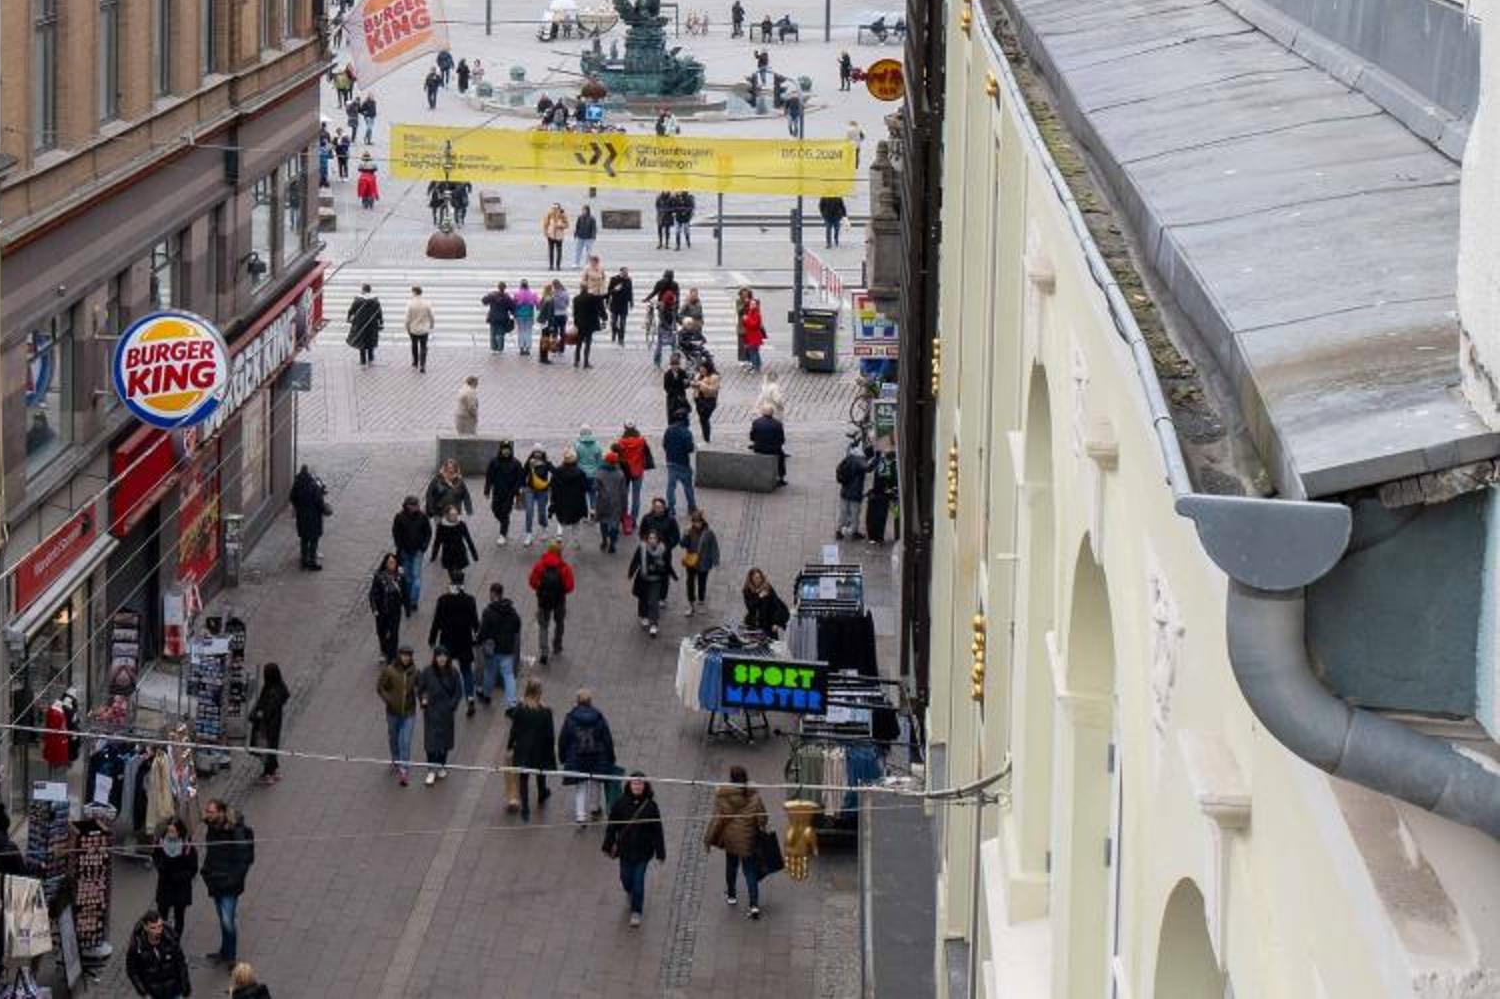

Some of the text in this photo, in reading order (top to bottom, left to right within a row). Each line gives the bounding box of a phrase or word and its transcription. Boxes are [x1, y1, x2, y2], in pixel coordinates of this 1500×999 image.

[365, 8, 432, 56] KING
[635, 157, 694, 169] Marathon
[126, 340, 215, 370] BURGER
[127, 361, 216, 398] KING
[734, 664, 815, 690] SPORT
[726, 685, 821, 710] MASTER
